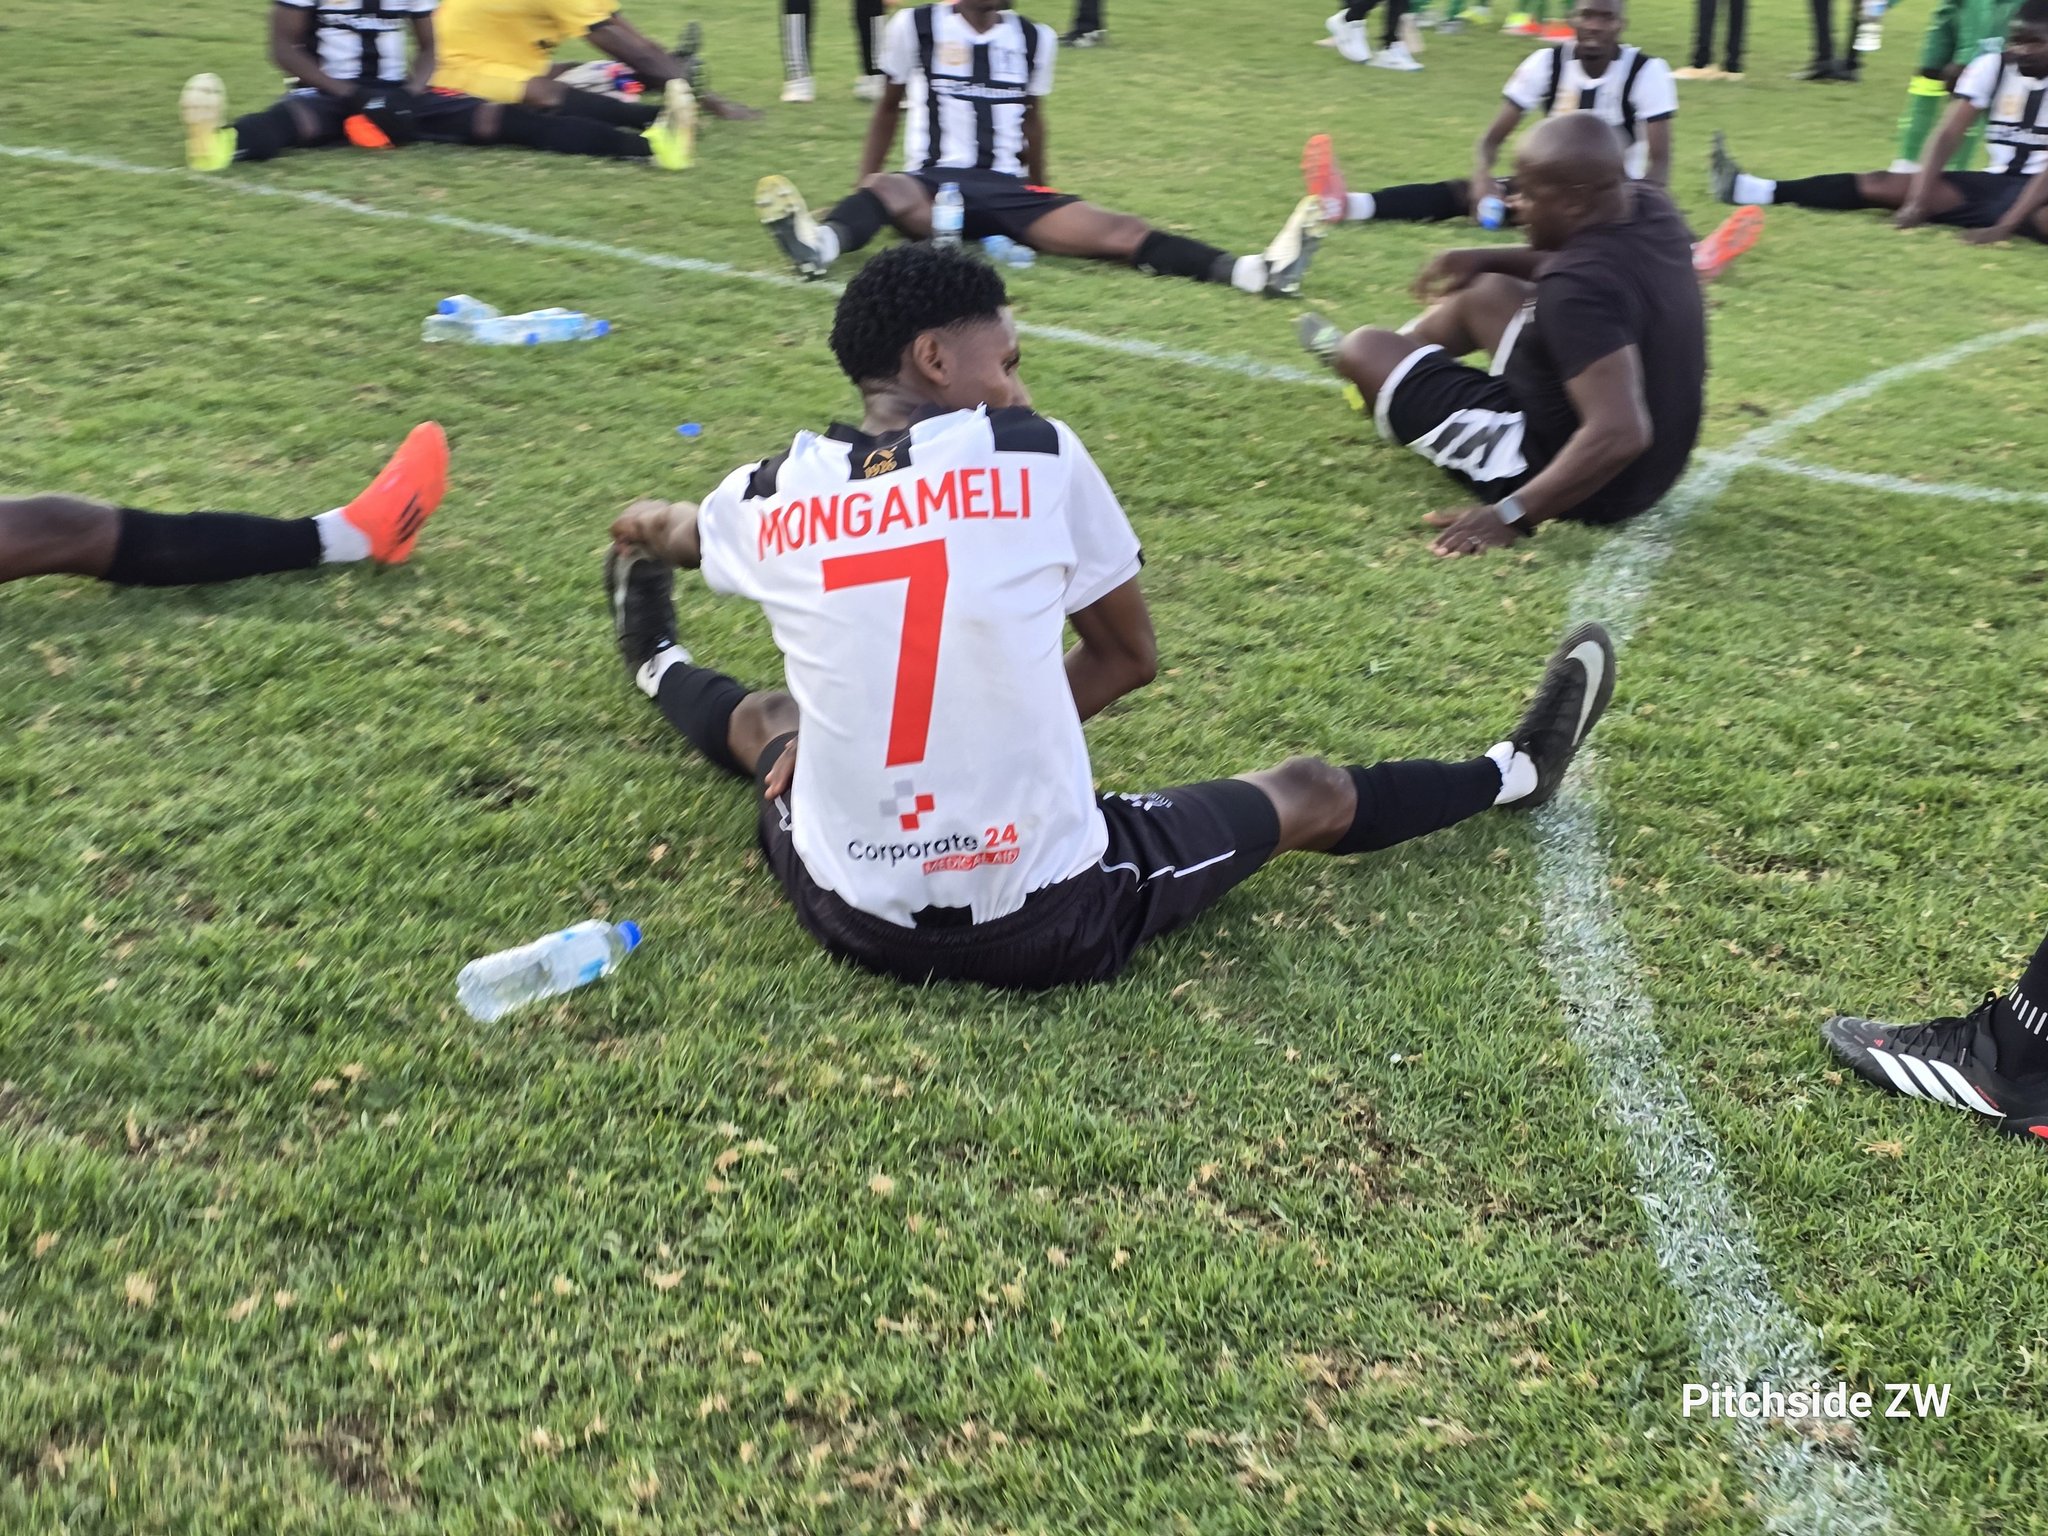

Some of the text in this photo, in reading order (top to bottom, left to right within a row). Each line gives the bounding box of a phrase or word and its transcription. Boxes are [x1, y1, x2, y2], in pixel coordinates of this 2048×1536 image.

[759, 467, 1031, 561] MONGAMELI
[821, 537, 949, 768] 7
[847, 822, 1018, 867] Corporate 24
